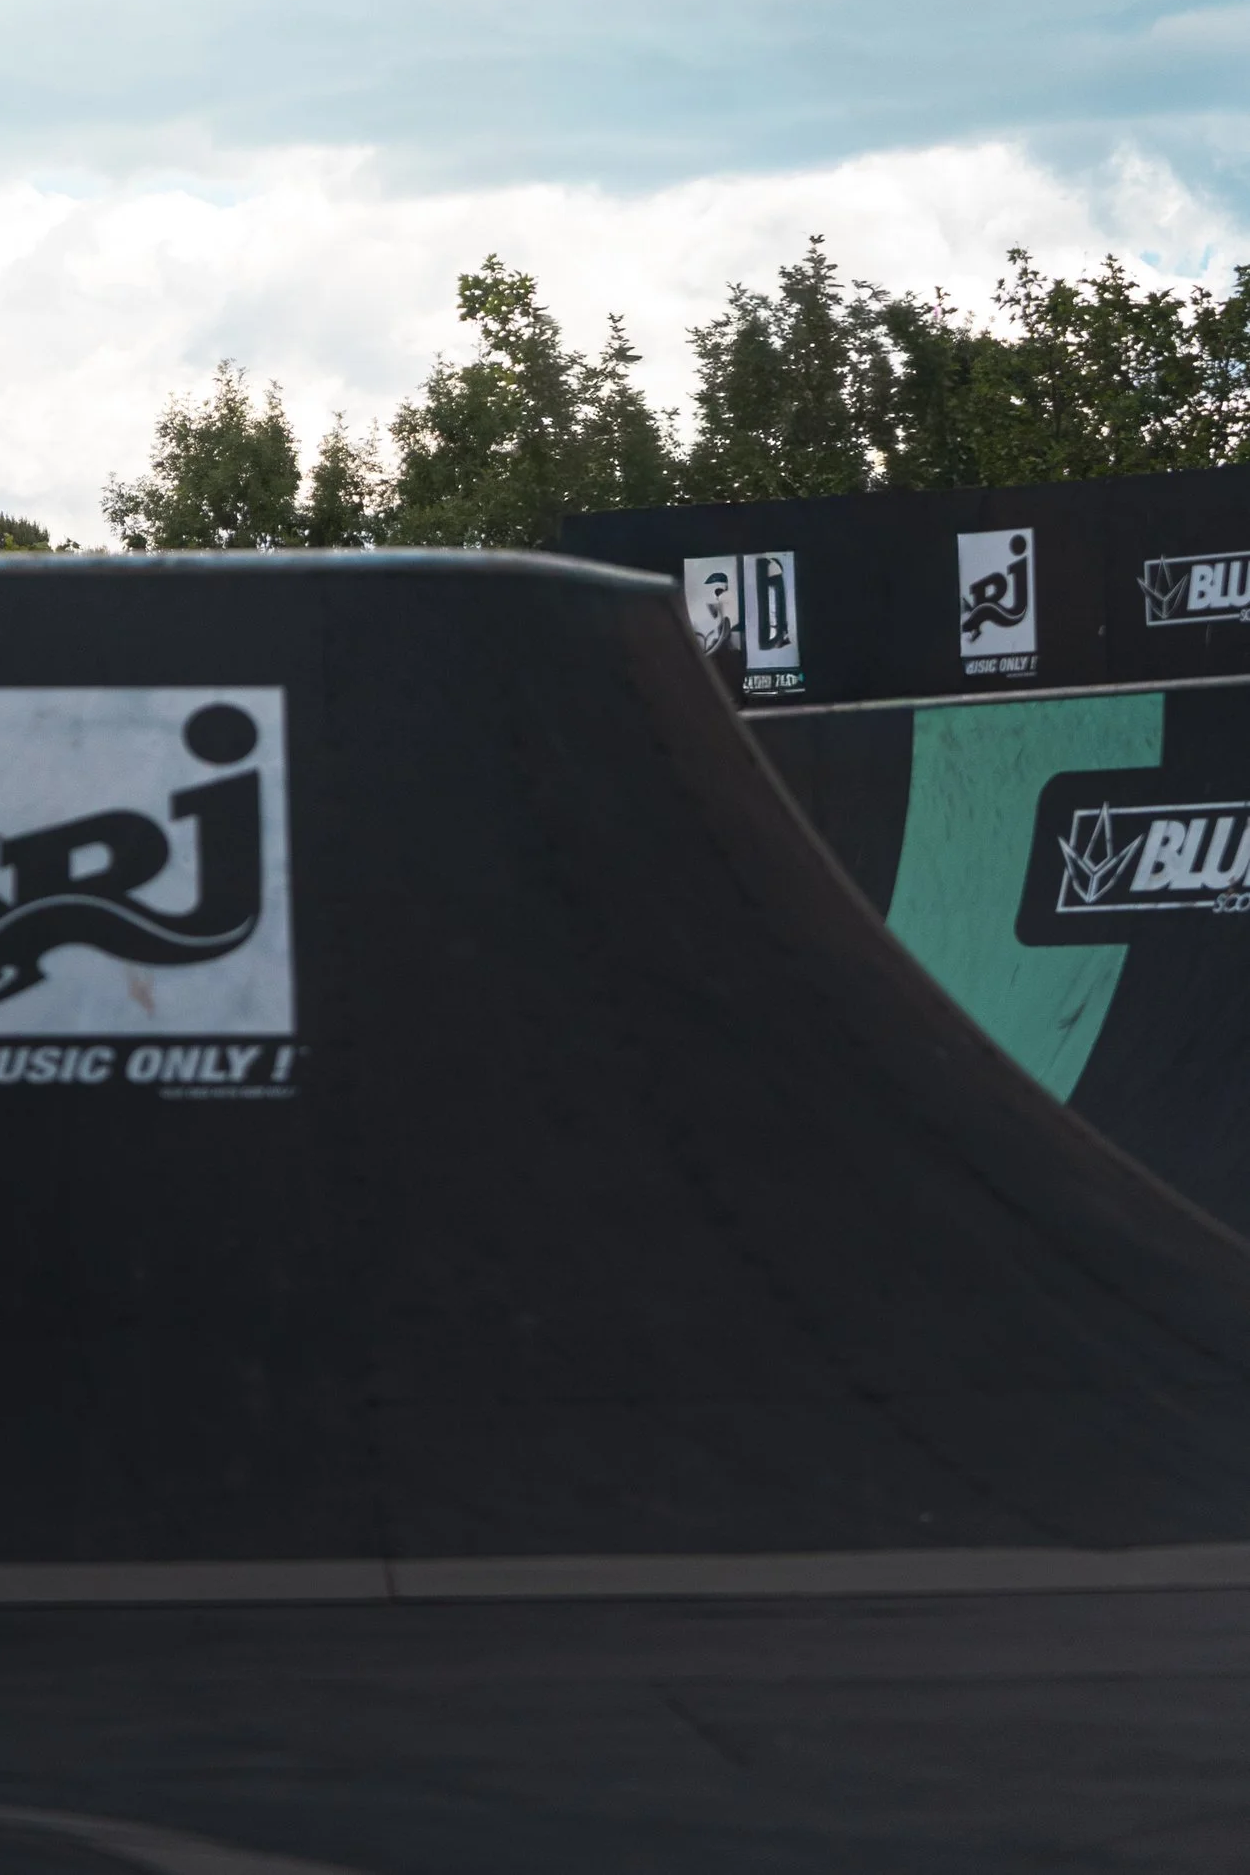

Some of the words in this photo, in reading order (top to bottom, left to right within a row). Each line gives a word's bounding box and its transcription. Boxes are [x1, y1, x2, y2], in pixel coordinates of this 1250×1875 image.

[999, 656, 1029, 673] ONLY
[124, 1045, 260, 1084] ONLY
[269, 1045, 294, 1082] !
